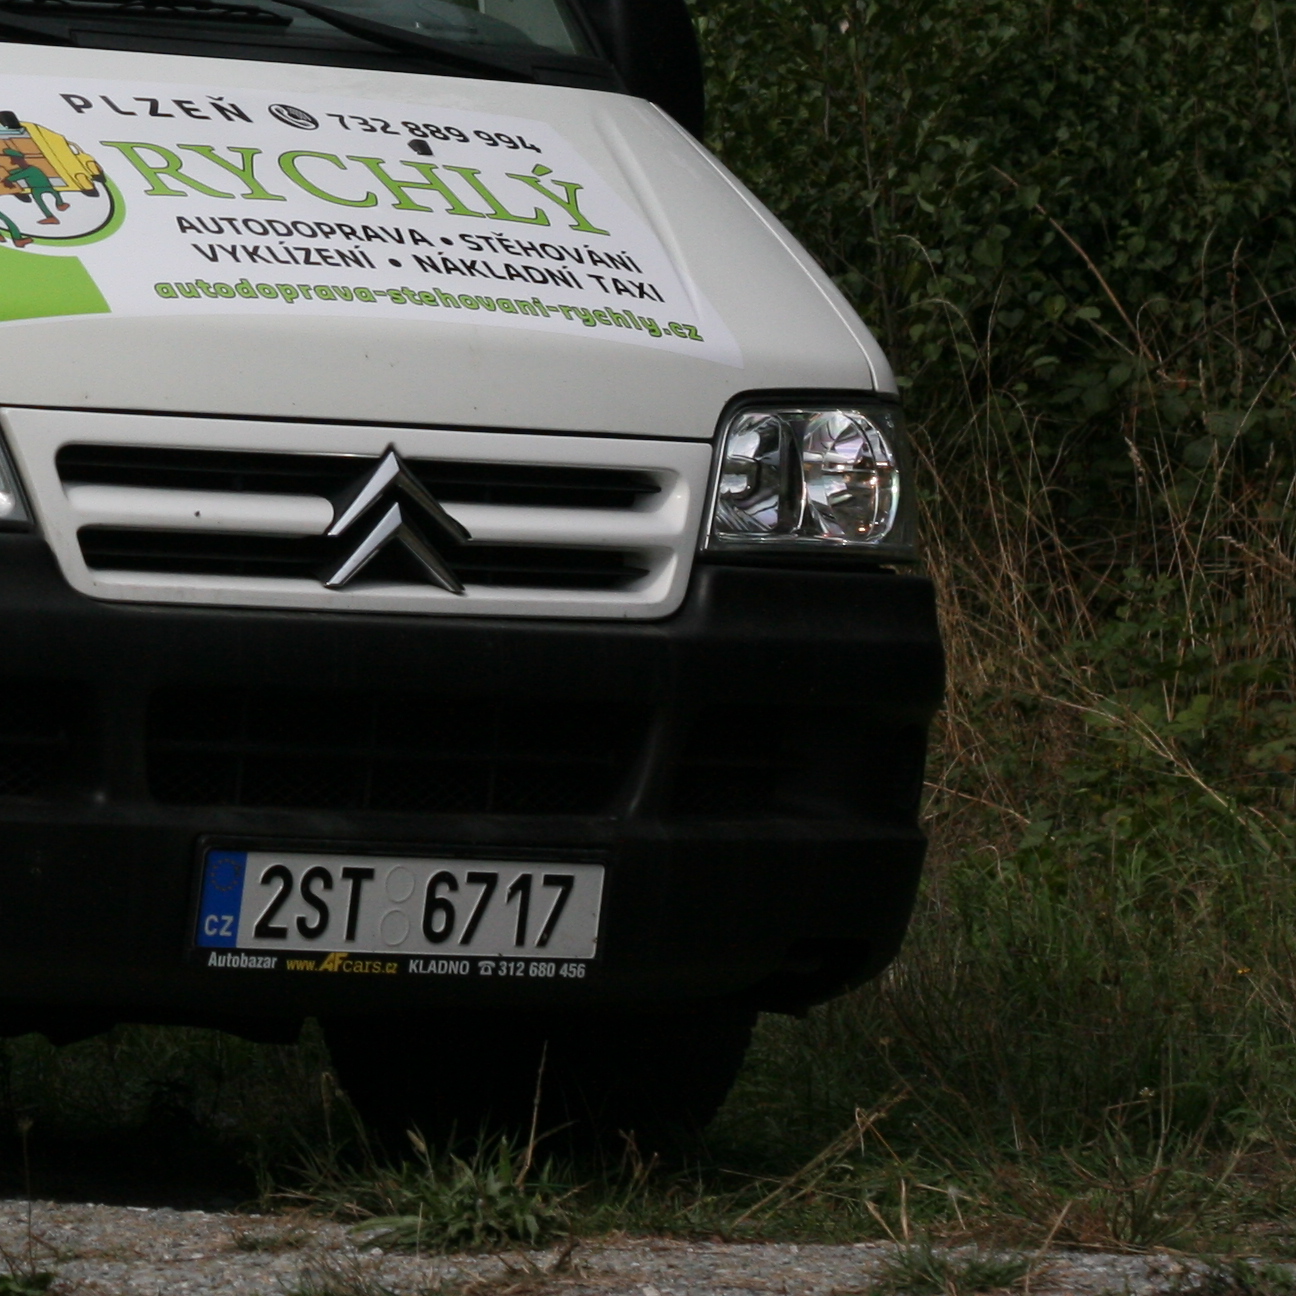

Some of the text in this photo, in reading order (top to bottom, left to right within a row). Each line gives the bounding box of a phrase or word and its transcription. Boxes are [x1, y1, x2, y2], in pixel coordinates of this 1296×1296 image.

[59, 93, 542, 154] PLZEŇ 732 889 994
[99, 140, 610, 236] RYCHLÝ
[176, 216, 643, 274] AUTODOPRAVA STĚHOVÁNÍ
[191, 241, 666, 303] VYKLÍZENÍ NÁKLADNÍ TAXI
[153, 278, 704, 342] autodoprava-stehovani-rychly.cz
[204, 914, 234, 937] CZ
[252, 863, 575, 948] 2ST 6717
[207, 951, 586, 979] Autobazar www.AFcars.cz KLADNO 312 680 456
